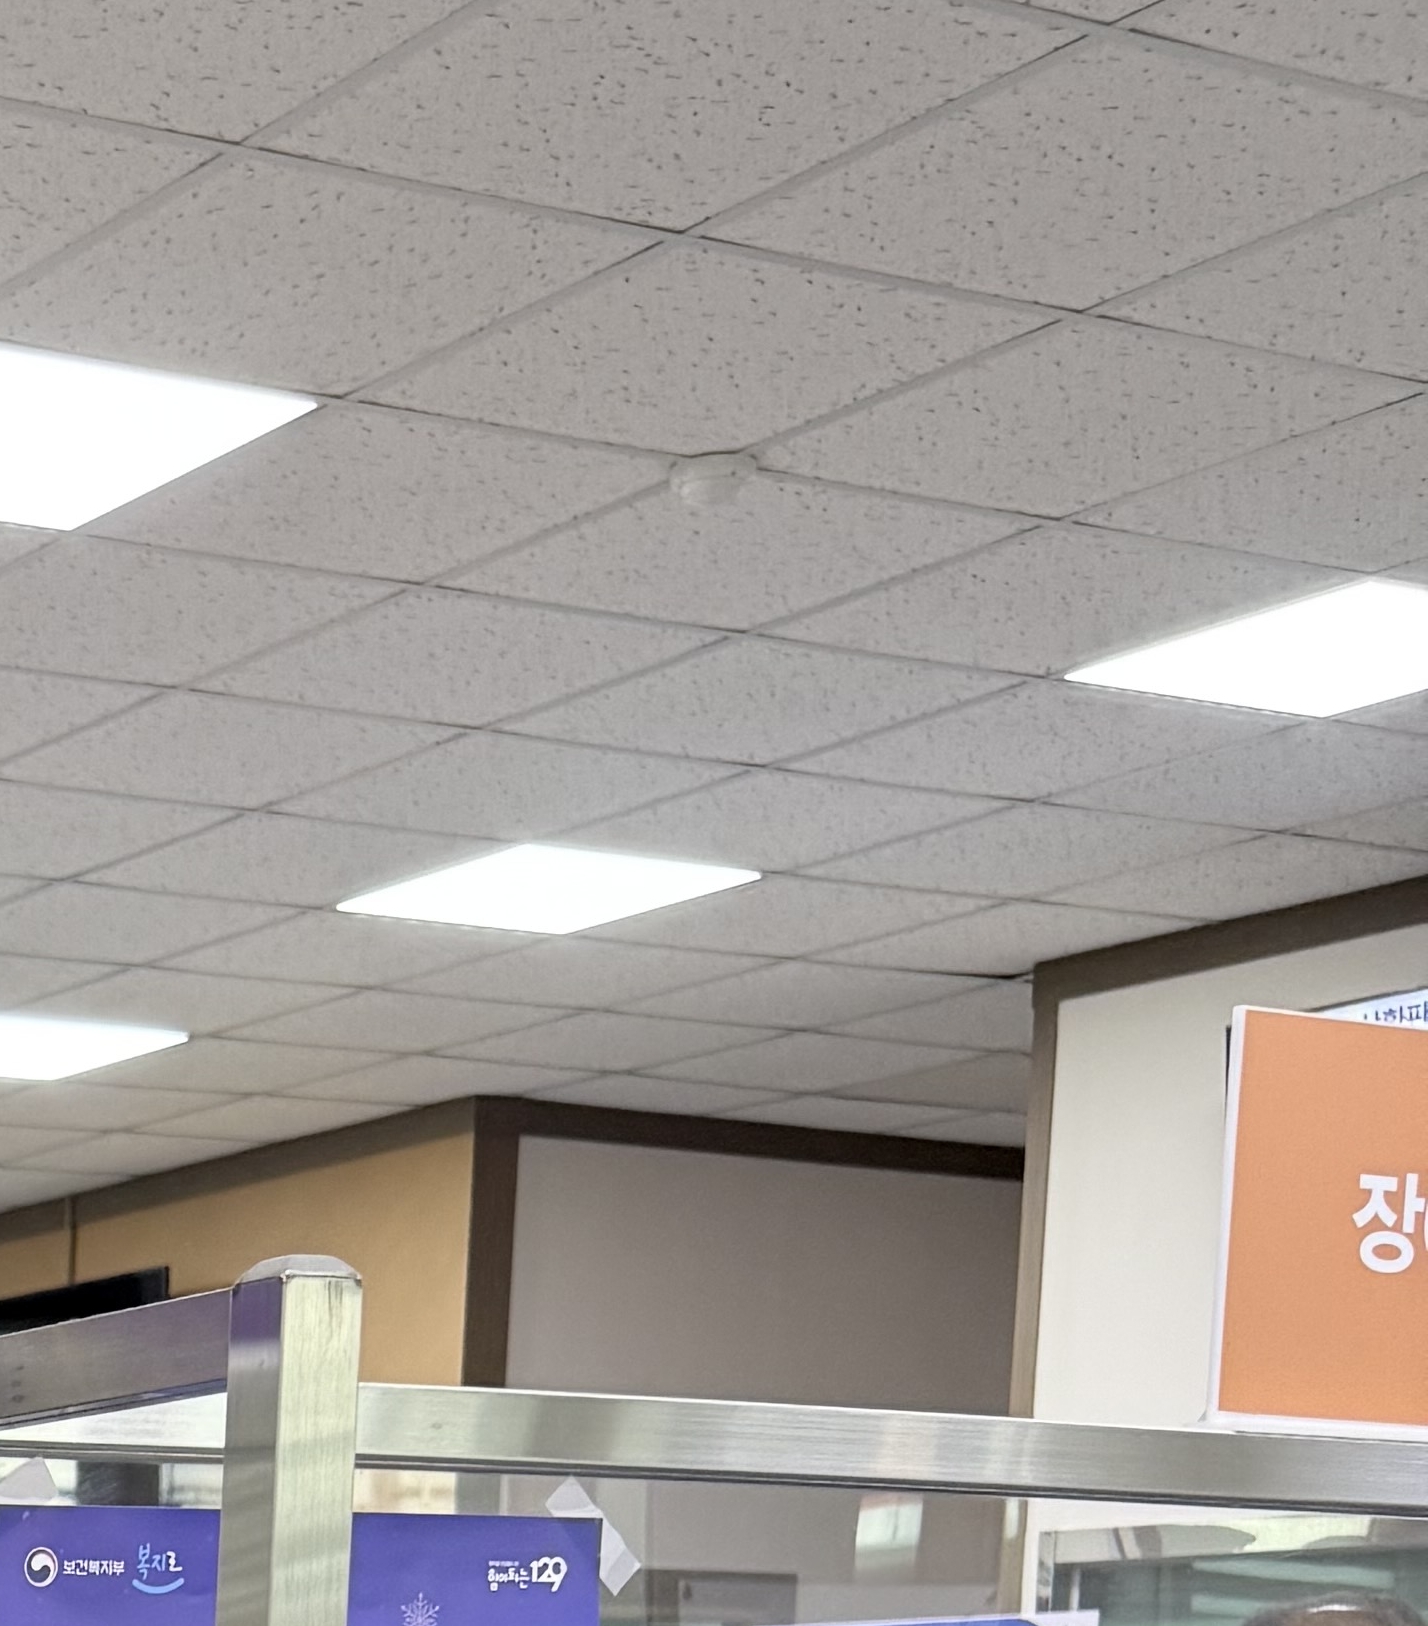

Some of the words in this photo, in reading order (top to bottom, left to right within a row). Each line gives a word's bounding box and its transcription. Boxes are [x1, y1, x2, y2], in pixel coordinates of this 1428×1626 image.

[1353, 1173, 1428, 1273] 장
[63, 1561, 124, 1575] 보건복지부
[137, 1543, 183, 1581] 복지로
